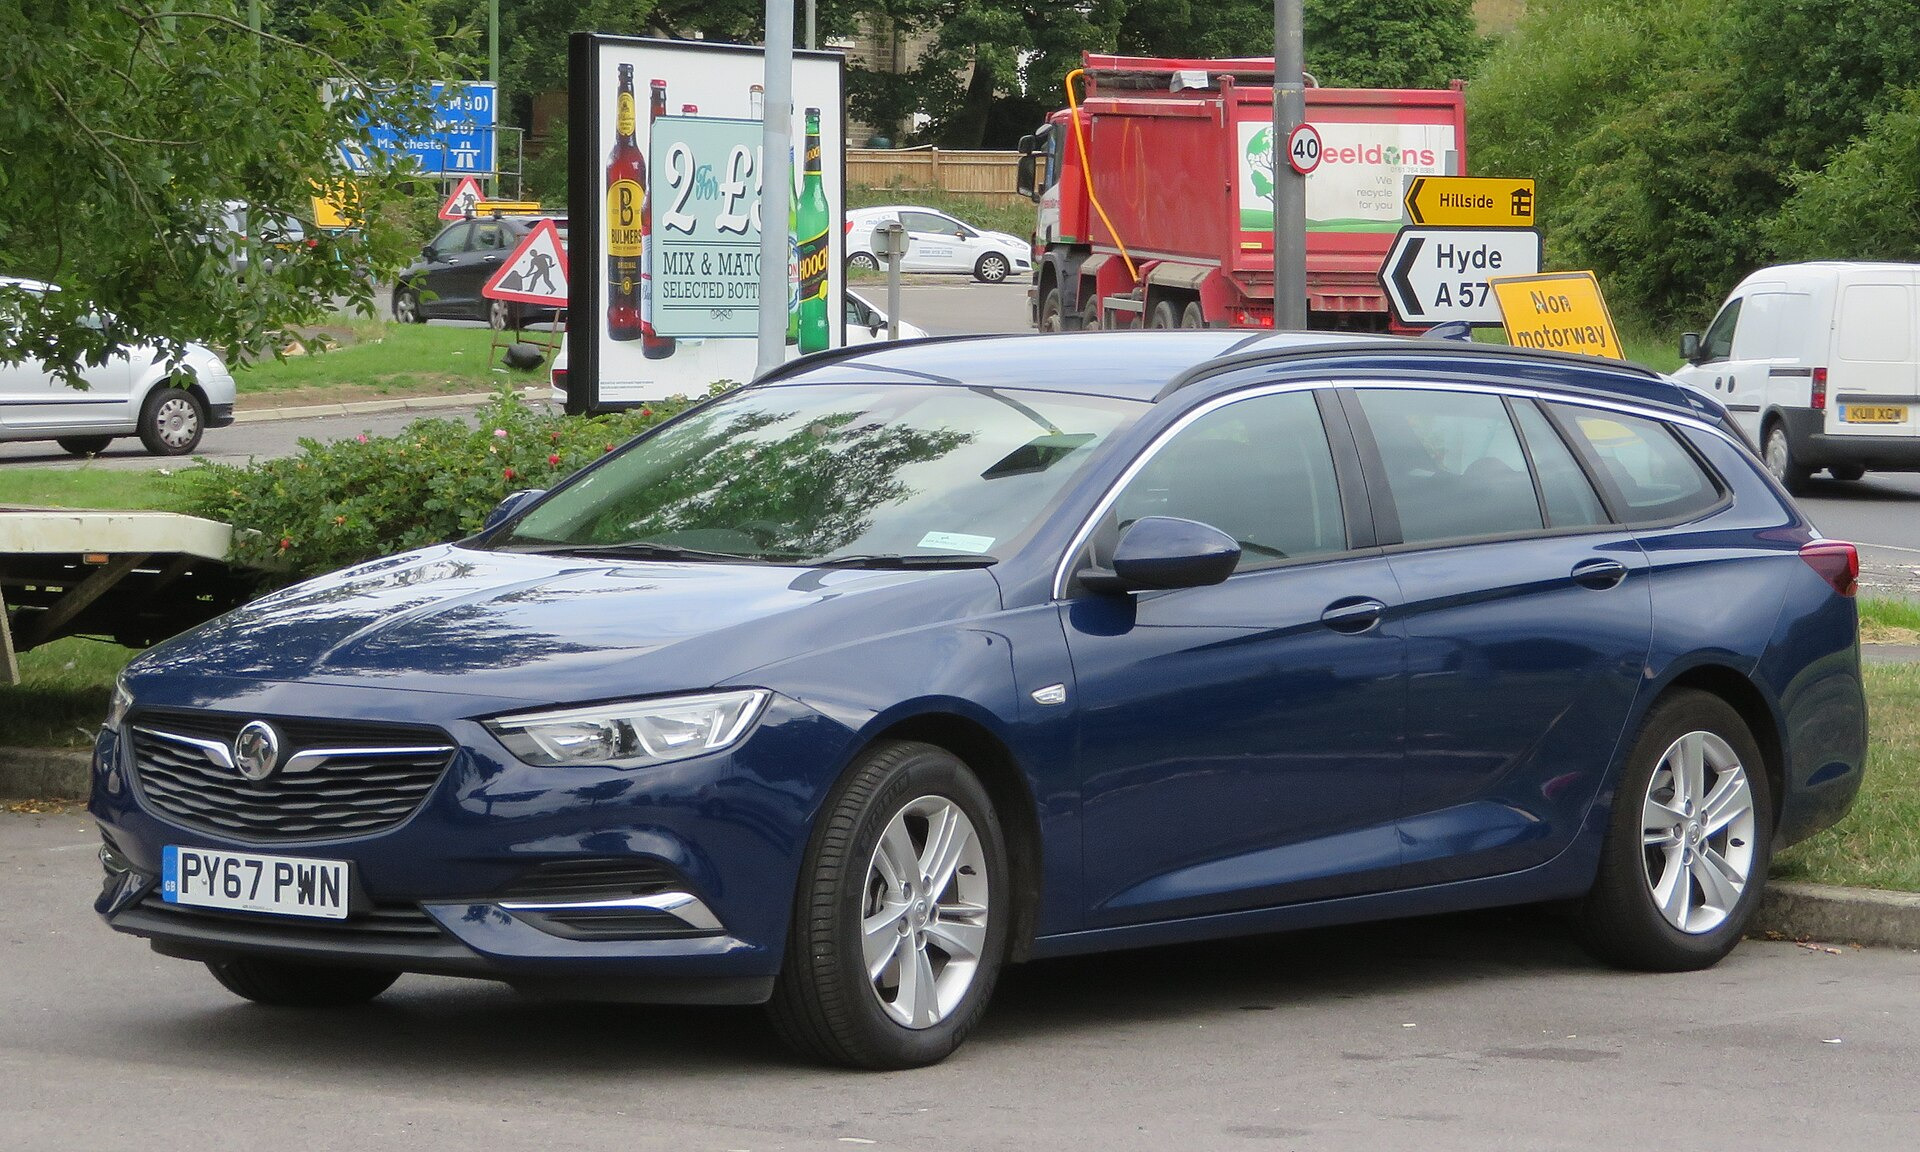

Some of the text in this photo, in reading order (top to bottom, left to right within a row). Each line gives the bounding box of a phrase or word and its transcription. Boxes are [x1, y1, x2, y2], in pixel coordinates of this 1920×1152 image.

[377, 138, 446, 150] Macheste
[1293, 138, 1318, 159] 40
[1322, 144, 1435, 166] eeldons
[663, 142, 697, 235] 2
[1376, 176, 1392, 185] We
[1357, 189, 1393, 199] recycle
[1439, 193, 1494, 209] Hillside
[1359, 200, 1393, 211] for you
[611, 228, 641, 244] BULMERS
[663, 252, 695, 275] MIX
[701, 252, 712, 275] &
[799, 245, 828, 281] HOOCH
[1437, 243, 1502, 273] Hyde
[663, 281, 725, 299] SELECTED
[727, 282, 759, 299] BOTT
[1530, 290, 1572, 315] Non
[1517, 323, 1606, 349] motorway
[165, 881, 176, 892] GB
[181, 852, 340, 908] PY67 PWN
